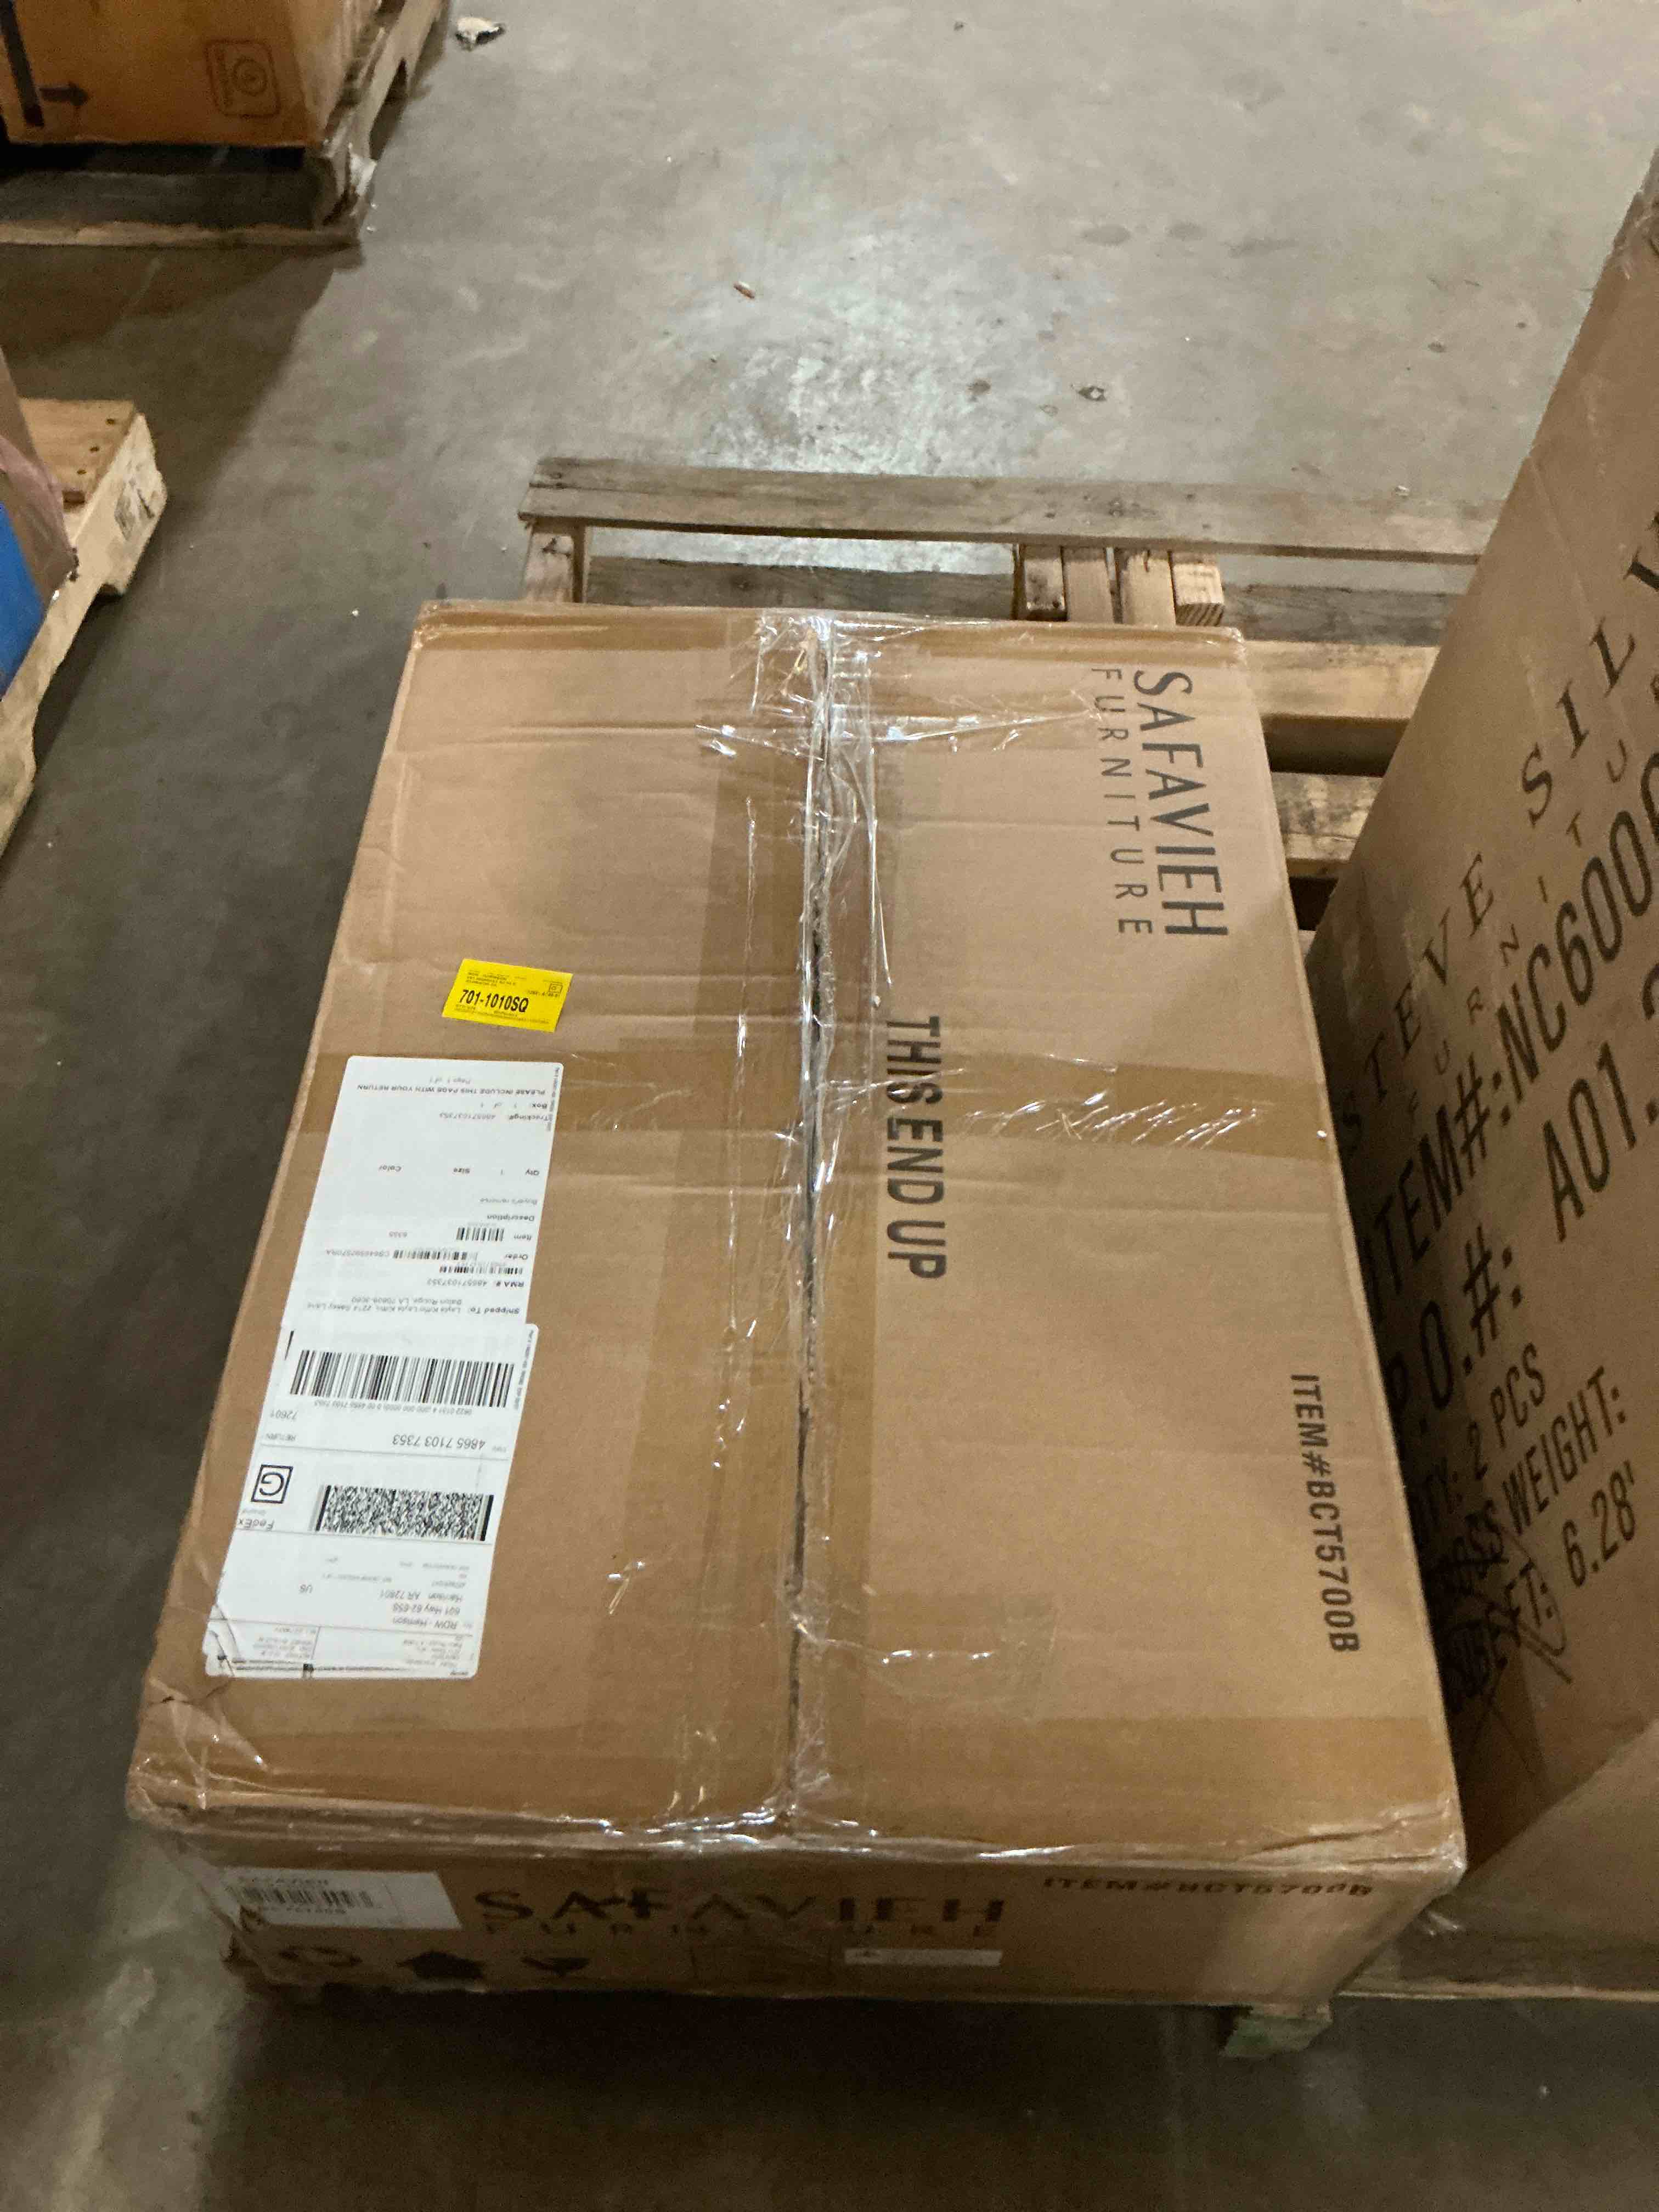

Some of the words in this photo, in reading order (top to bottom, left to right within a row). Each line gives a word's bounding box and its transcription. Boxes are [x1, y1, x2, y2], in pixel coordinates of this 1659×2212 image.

[1092, 668, 1153, 933] FURNITURE
[1133, 670, 1228, 935] SAFAVIEH
[459, 989, 529, 1013] 701-1010SQ
[887, 1016, 943, 1104] THIS
[1542, 962, 1659, 1242] A01.
[887, 1117, 944, 1205] END
[887, 1219, 946, 1279] UP
[1489, 1342, 1545, 1448] PCS
[270, 1409, 298, 1421] 72601
[265, 1432, 297, 1442] RETURN
[392, 1434, 421, 1447] 7353
[424, 1436, 453, 1448] 7103
[456, 1437, 486, 1450] 4865
[1502, 1365, 1626, 1536] WEIGHT:
[259, 1472, 284, 1497] G
[236, 1518, 275, 1532] FedEx
[1291, 1374, 1361, 1652] ITEM#BCT5700B
[299, 1584, 313, 1594] US
[407, 1591, 421, 1600] AR
[425, 1602, 443, 1615] Hwy
[434, 1620, 458, 1630] RDW
[475, 1887, 1003, 1922] SAFAVIEH
